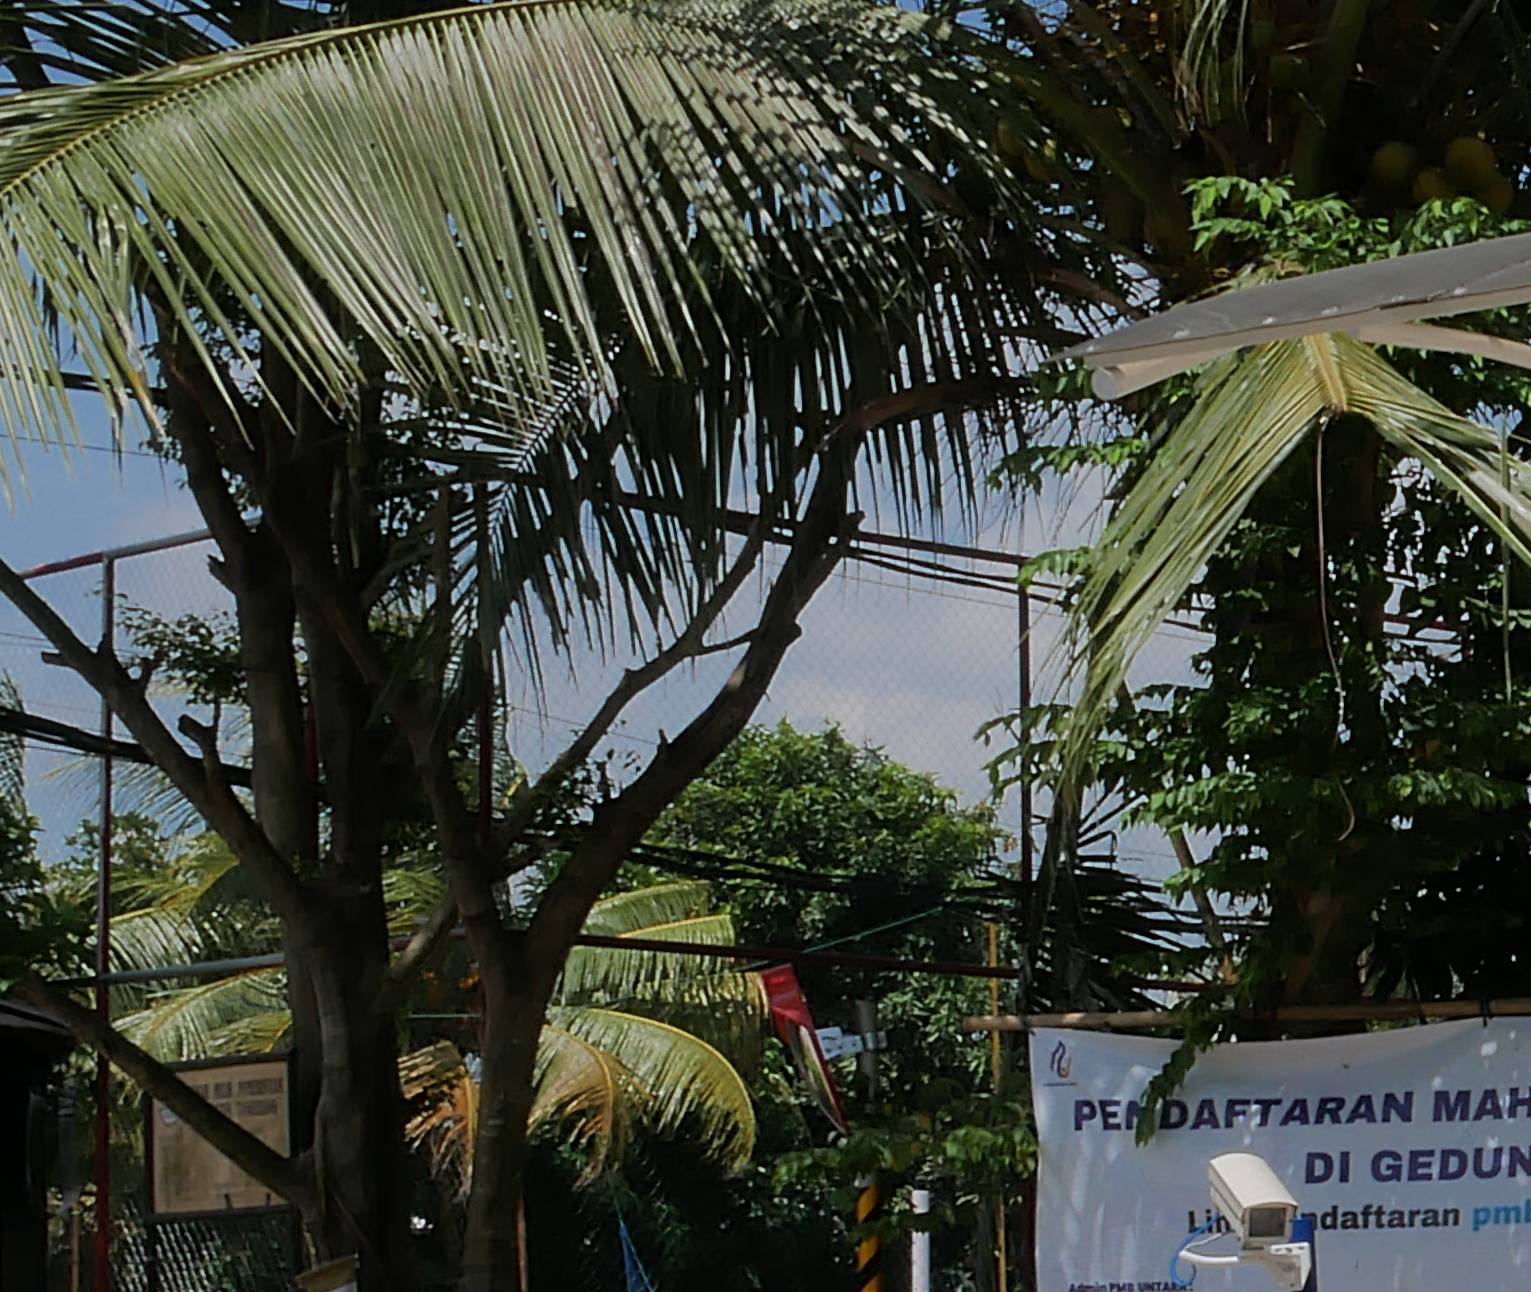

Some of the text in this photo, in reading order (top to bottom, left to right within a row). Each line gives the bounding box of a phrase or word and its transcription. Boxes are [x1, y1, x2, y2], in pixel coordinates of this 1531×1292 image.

[1305, 1150, 1350, 1184] DI
[1188, 1208, 1233, 1233] Lin
[1301, 1204, 1460, 1231] daftaran
[1109, 1282, 1135, 1292] PMB
